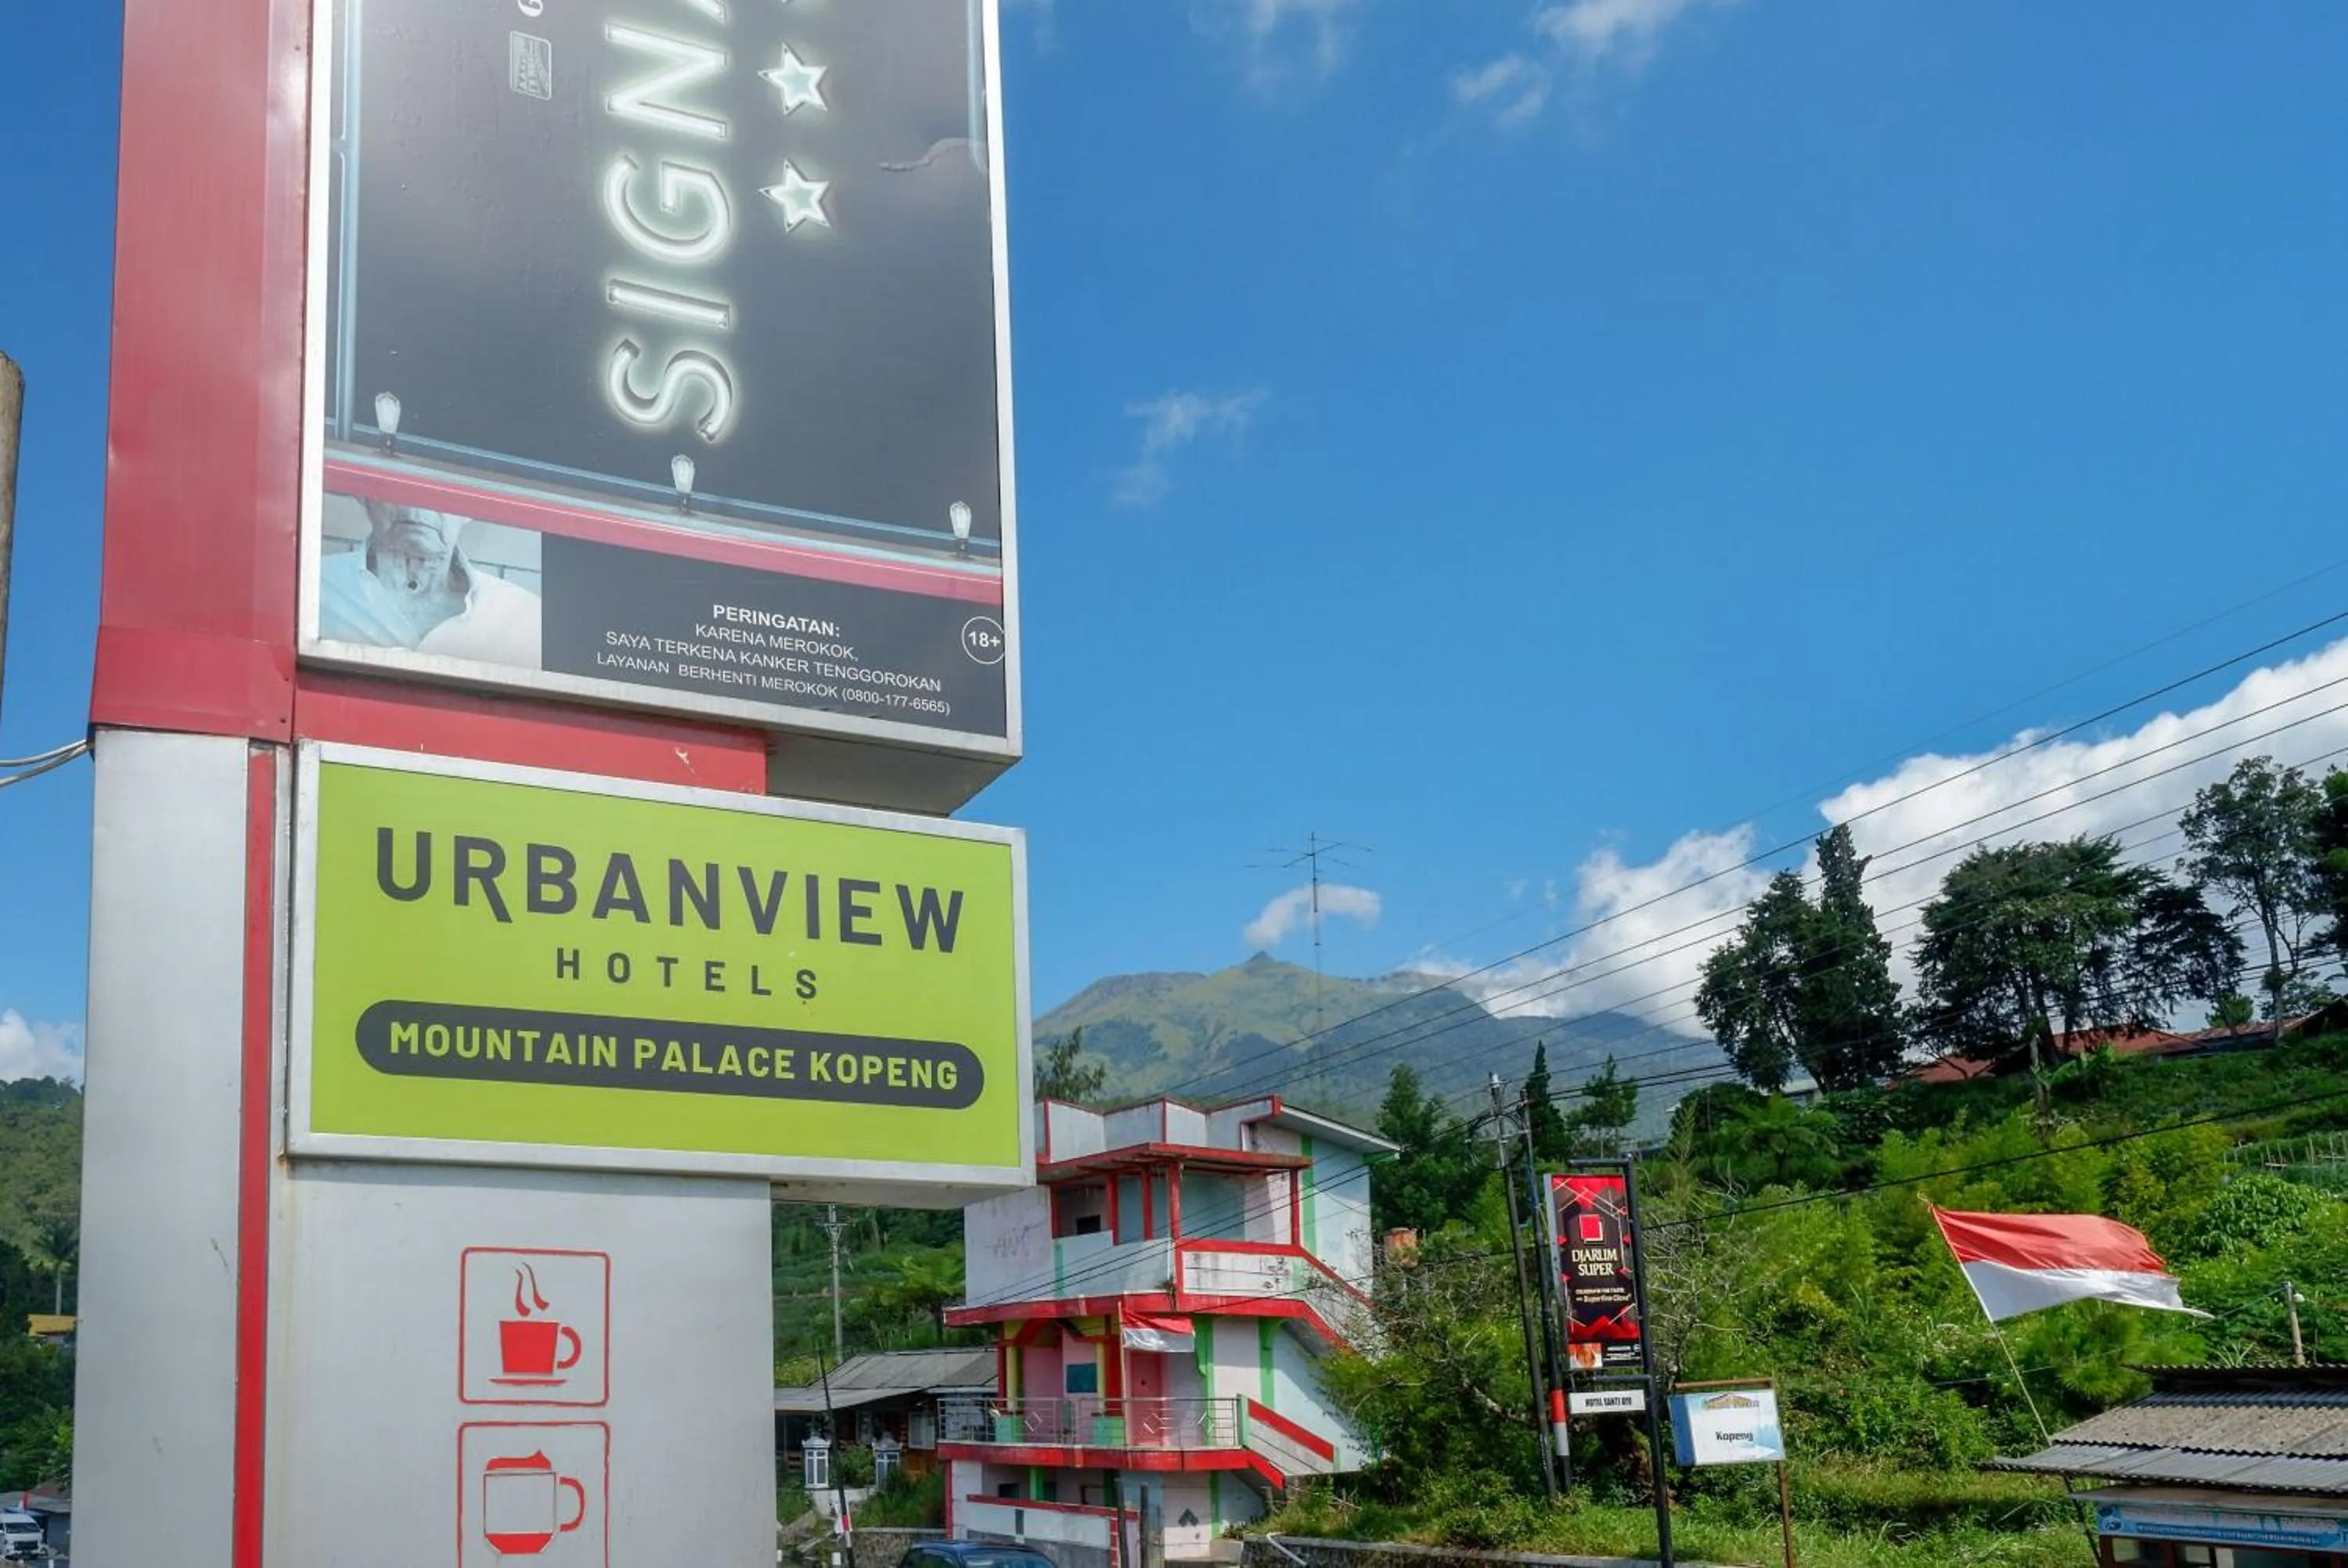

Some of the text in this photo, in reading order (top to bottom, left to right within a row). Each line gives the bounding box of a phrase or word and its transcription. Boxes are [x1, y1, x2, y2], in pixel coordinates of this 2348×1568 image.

[605, 0, 733, 443] SIGN
[696, 624, 859, 662] KARENA MEROKOK,
[713, 604, 841, 638] PERINGATAN:
[968, 631, 1001, 648] 18+
[597, 652, 951, 716] LAYANAN BERHENTI MEROKOK (0800-177-6565)
[607, 631, 941, 692] SAYA TERKENA KANKER TENGGOROKAN
[376, 827, 963, 953] URBANVIEW
[556, 948, 818, 1000] HOTELS
[390, 1021, 958, 1091] MOUNTAIN PALACE KOPENG
[1572, 1249, 1617, 1263] DJARUM
[1578, 1262, 1614, 1276] SUPER
[1716, 1431, 1753, 1443] Kopeng
